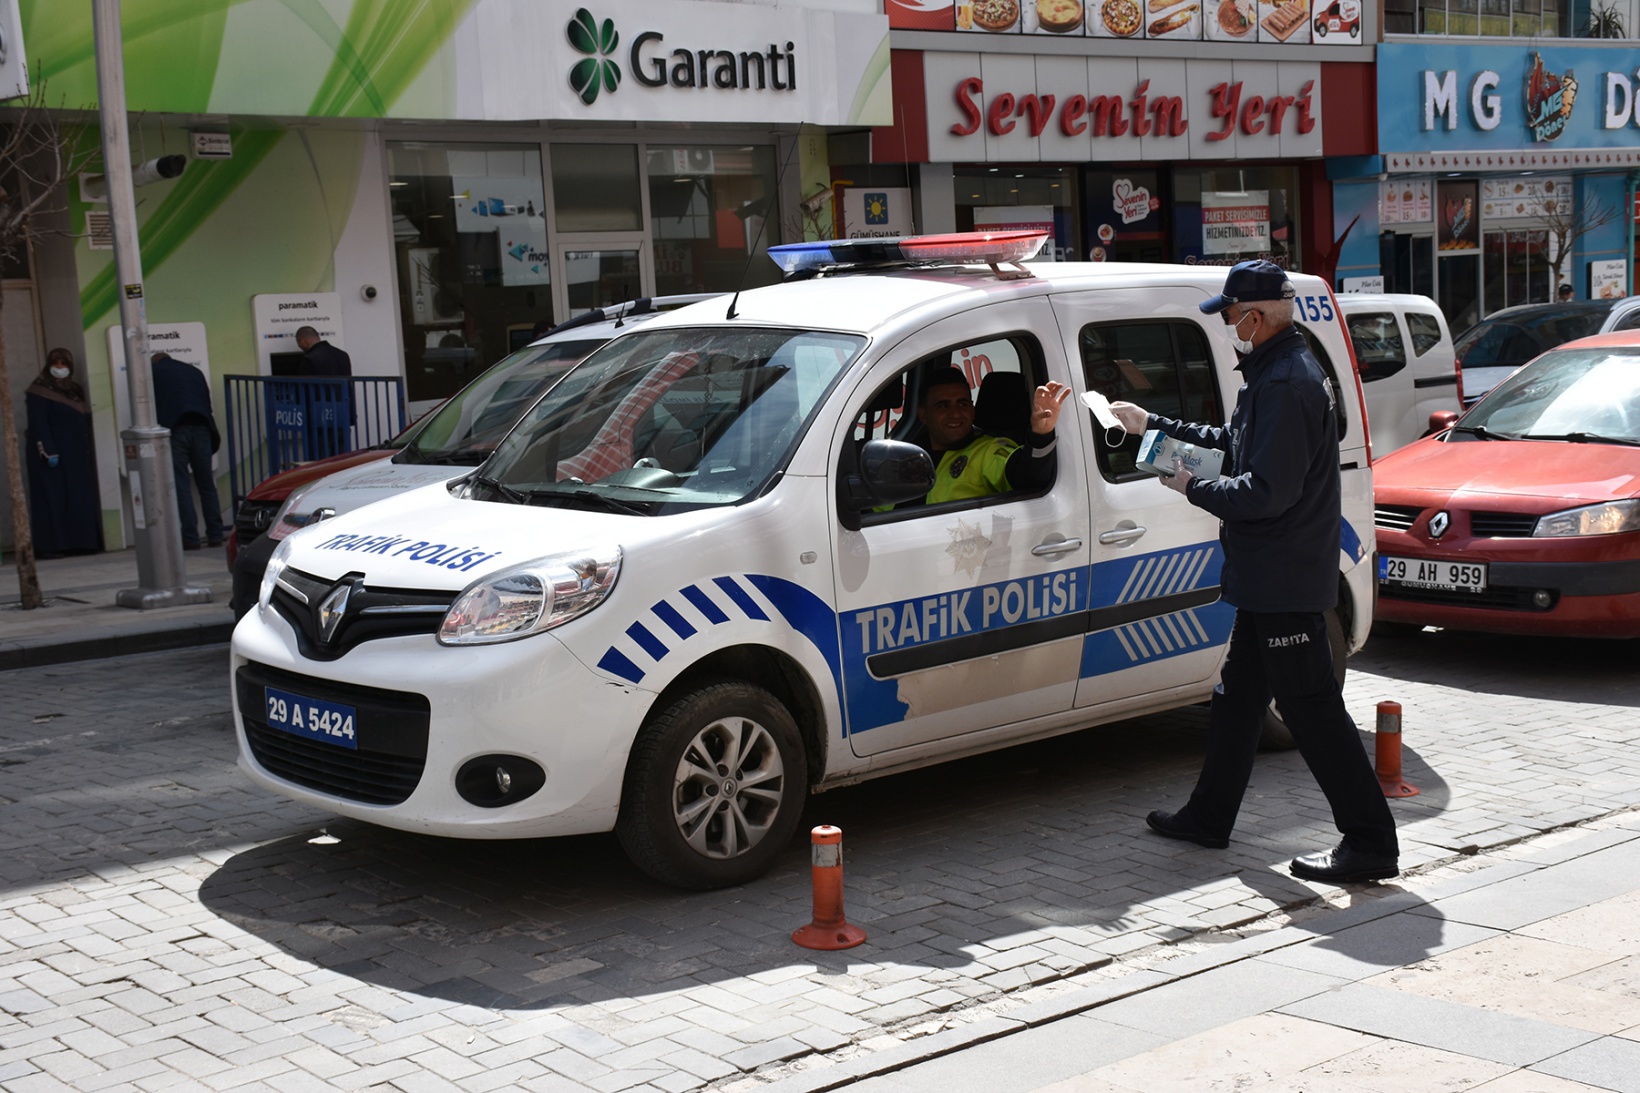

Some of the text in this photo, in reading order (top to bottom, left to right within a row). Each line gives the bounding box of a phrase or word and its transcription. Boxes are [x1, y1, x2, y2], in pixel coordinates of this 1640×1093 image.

[629, 31, 797, 91] Garanti
[950, 77, 1315, 141] Sevenin Yeri
[1602, 67, 1640, 129] D
[1537, 115, 1567, 142] Döner
[1205, 207, 1267, 222] PAKET SERVİSİMİZLE
[278, 301, 318, 311] paramatik
[1295, 295, 1334, 322] 155
[147, 331, 181, 341] ramatik
[275, 407, 304, 428] POLİS
[313, 534, 502, 572] TRAFİK POLİSİ
[1388, 560, 1482, 586] 29 AH 959
[855, 571, 1077, 654] TRAFİK POLİSİ
[1267, 632, 1310, 648] ZABITA
[268, 696, 355, 740] 29 A 5424
